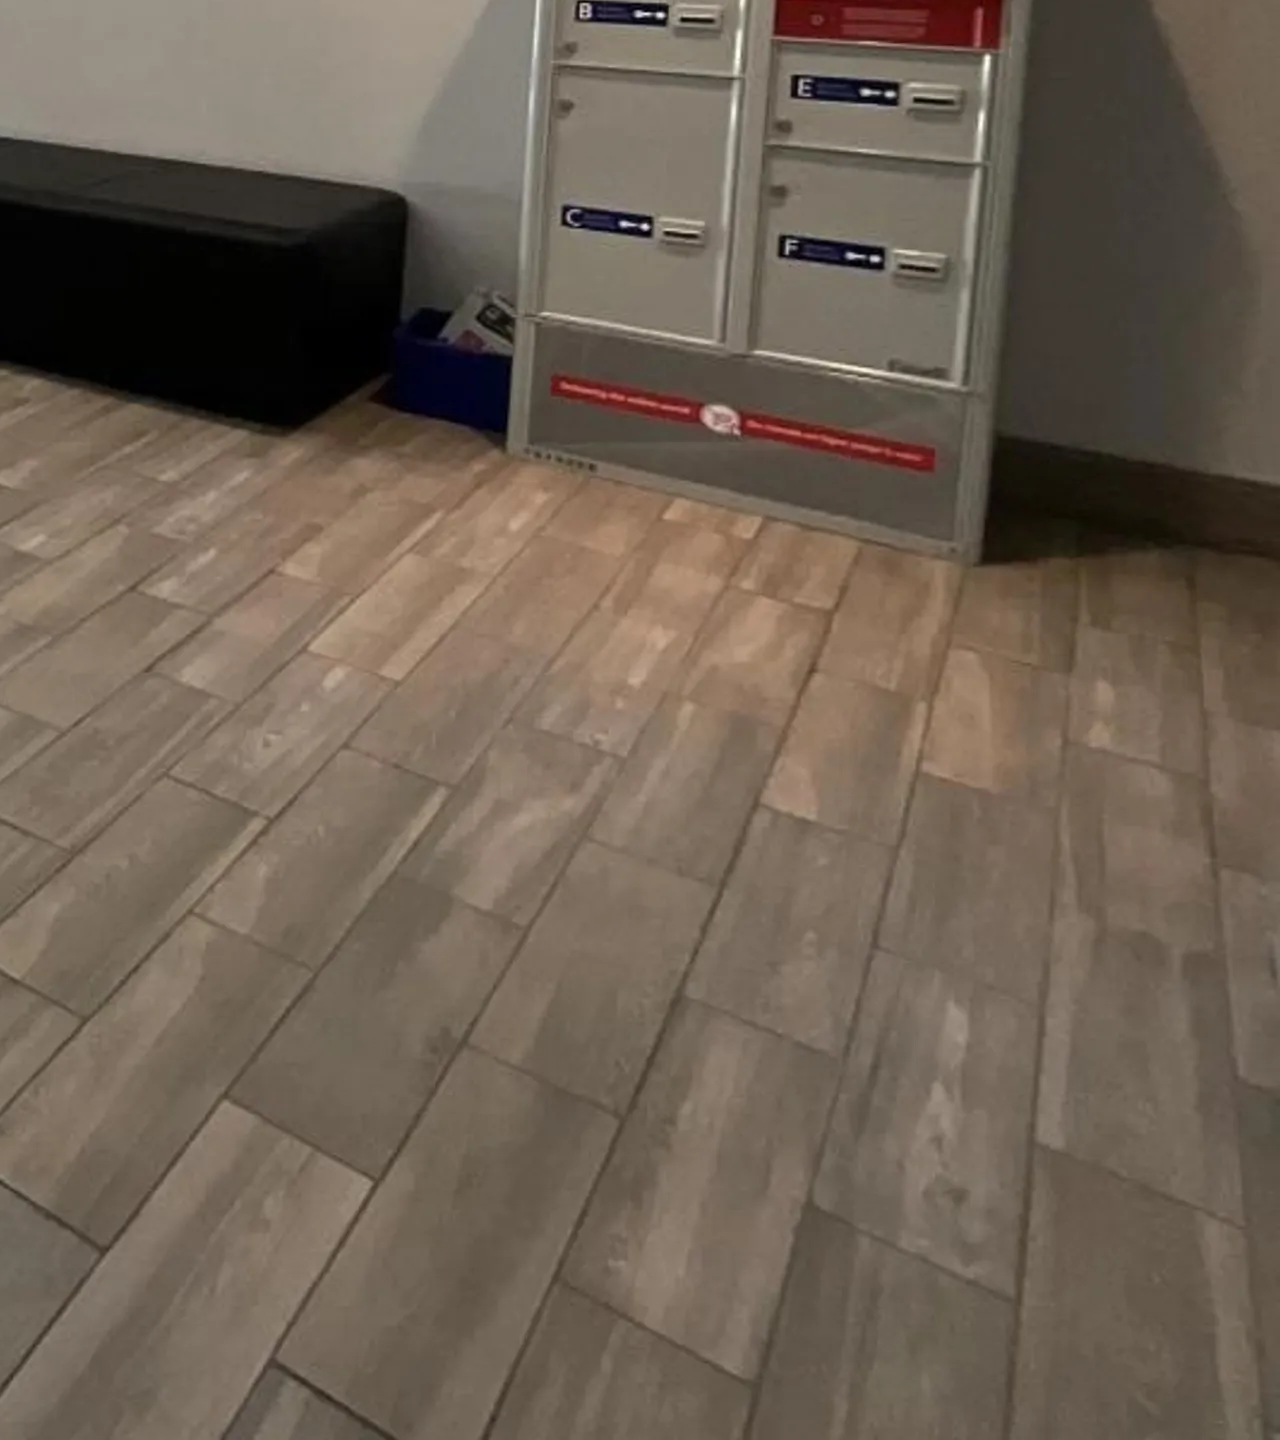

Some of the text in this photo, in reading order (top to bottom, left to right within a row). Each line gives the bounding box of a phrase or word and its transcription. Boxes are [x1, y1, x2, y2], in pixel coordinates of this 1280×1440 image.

[578, 2, 593, 20] B
[797, 77, 814, 98] E
[565, 208, 583, 228] C
[784, 238, 799, 257] F
